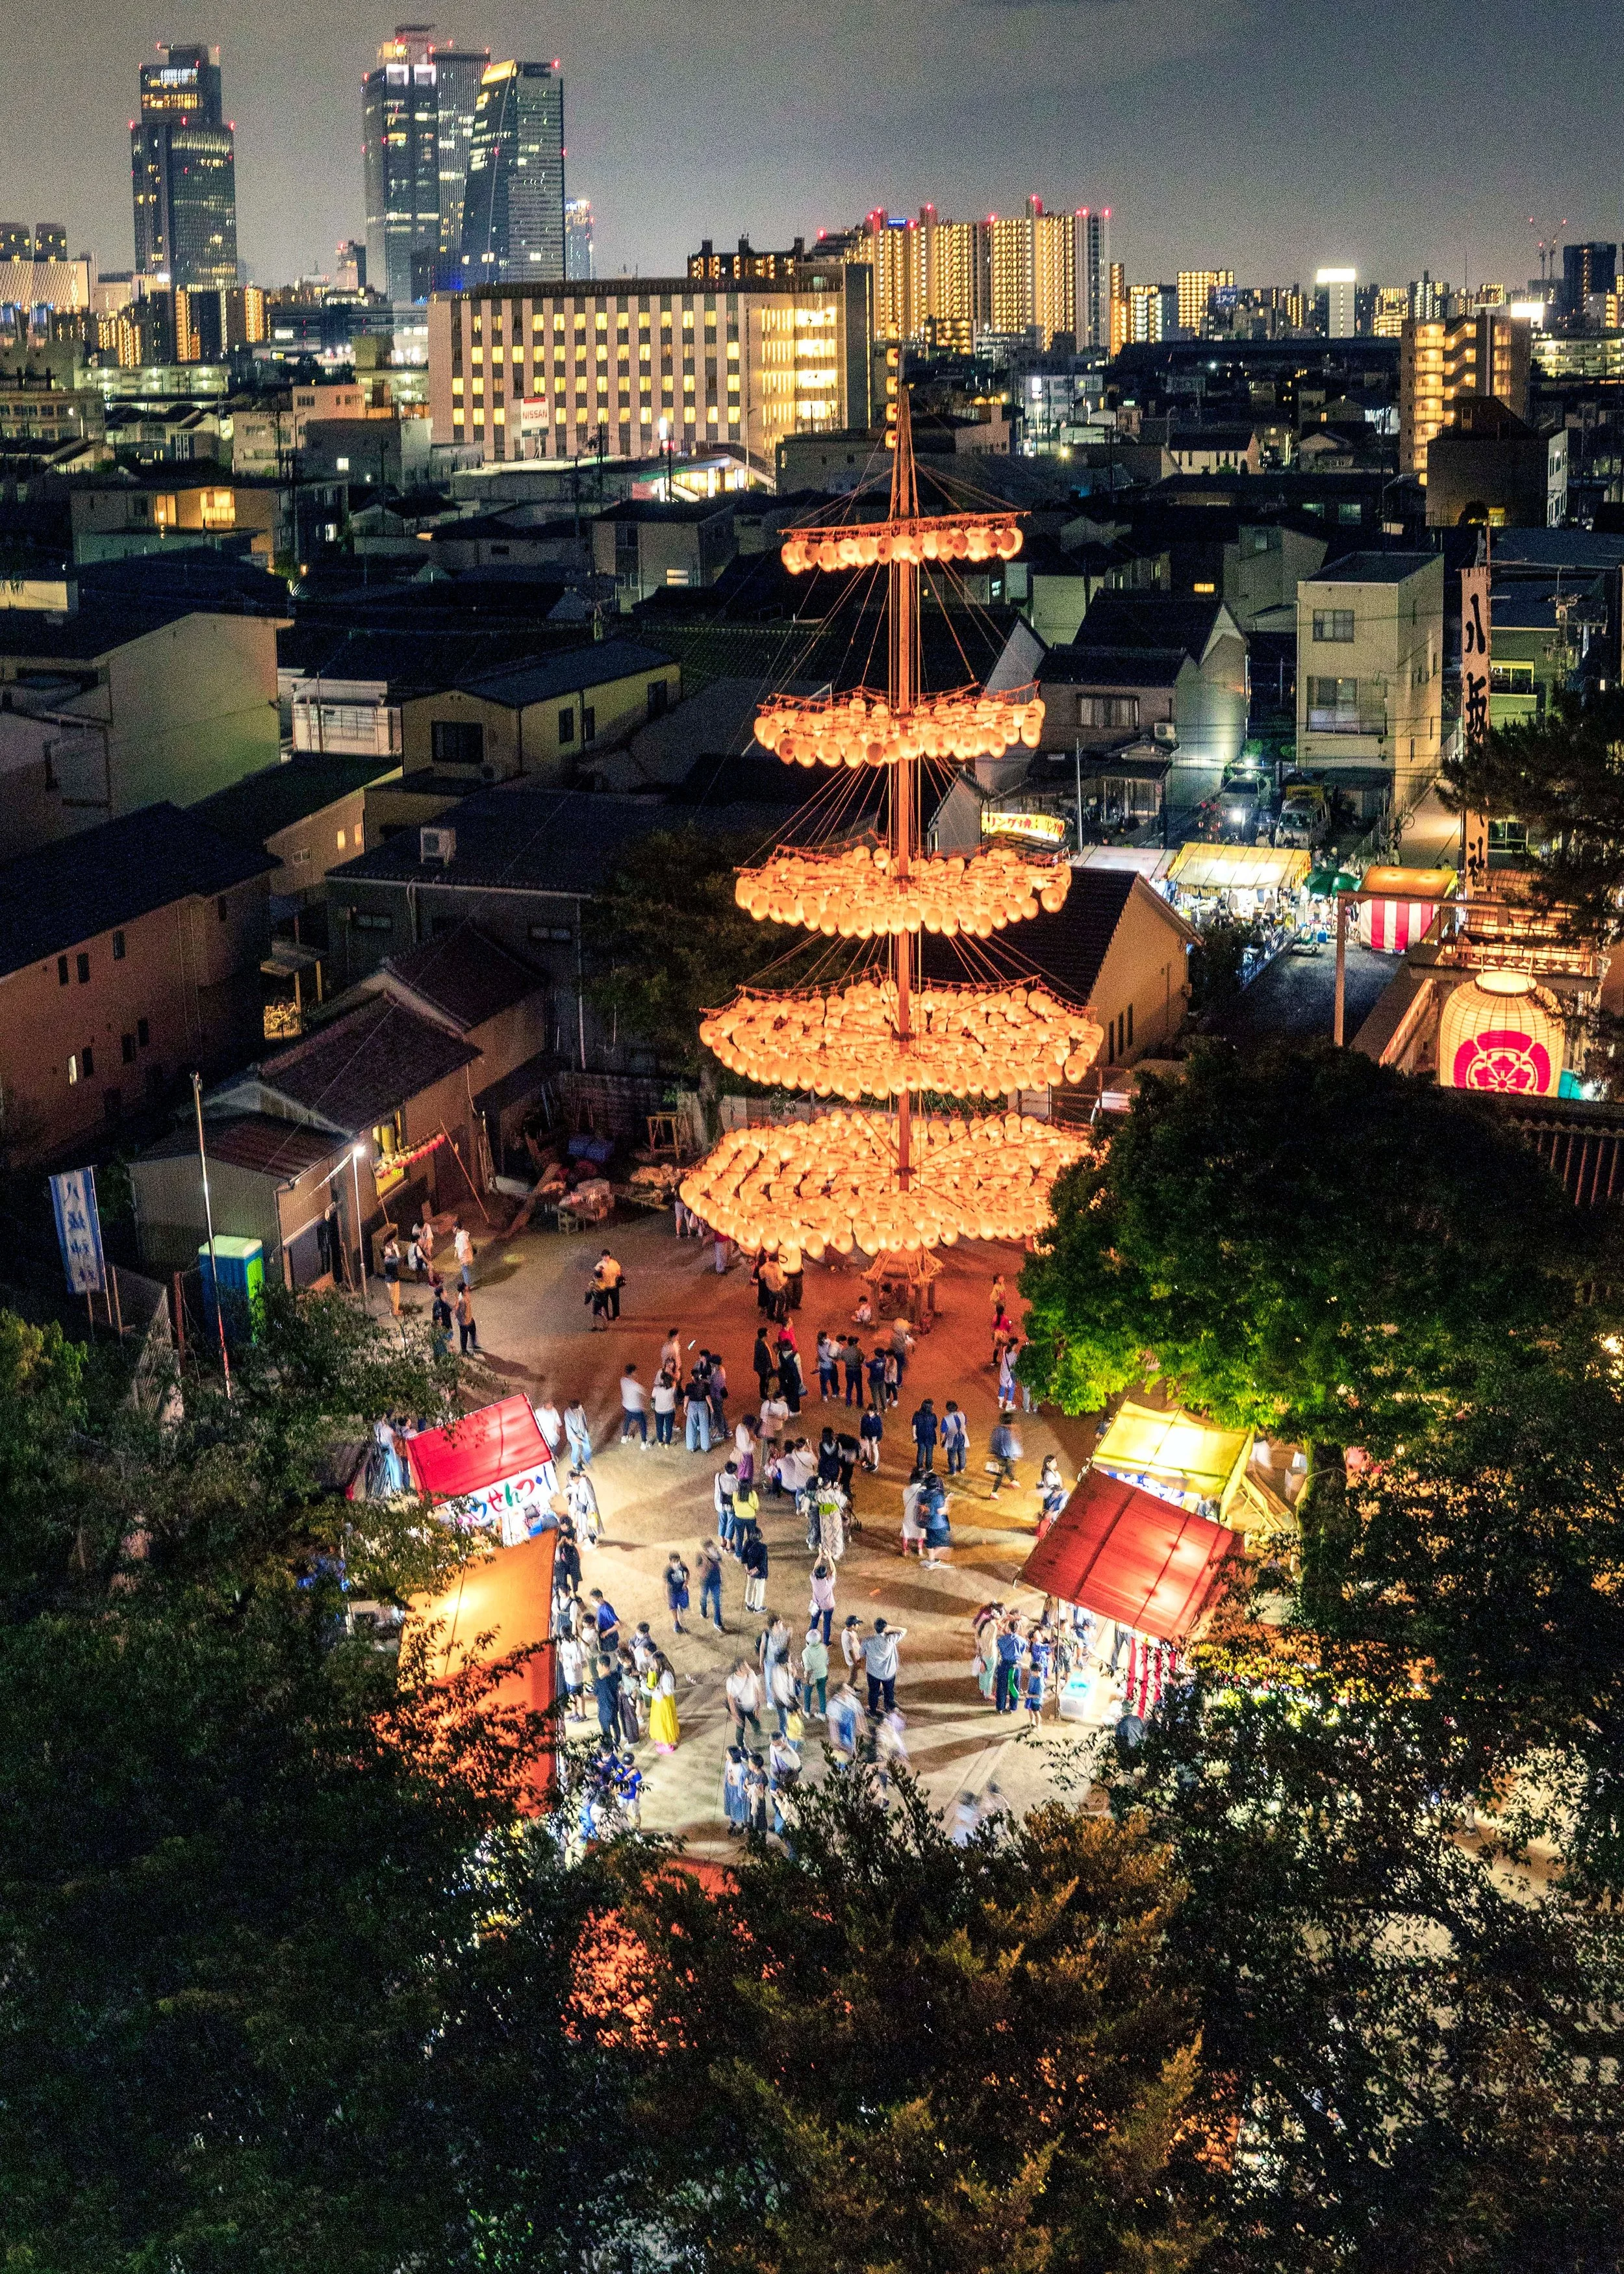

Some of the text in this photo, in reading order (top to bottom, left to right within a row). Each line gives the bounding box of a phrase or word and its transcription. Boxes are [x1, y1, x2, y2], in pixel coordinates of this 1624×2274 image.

[522, 409, 548, 419] NISSAN
[1464, 593, 1487, 887] 八坂社
